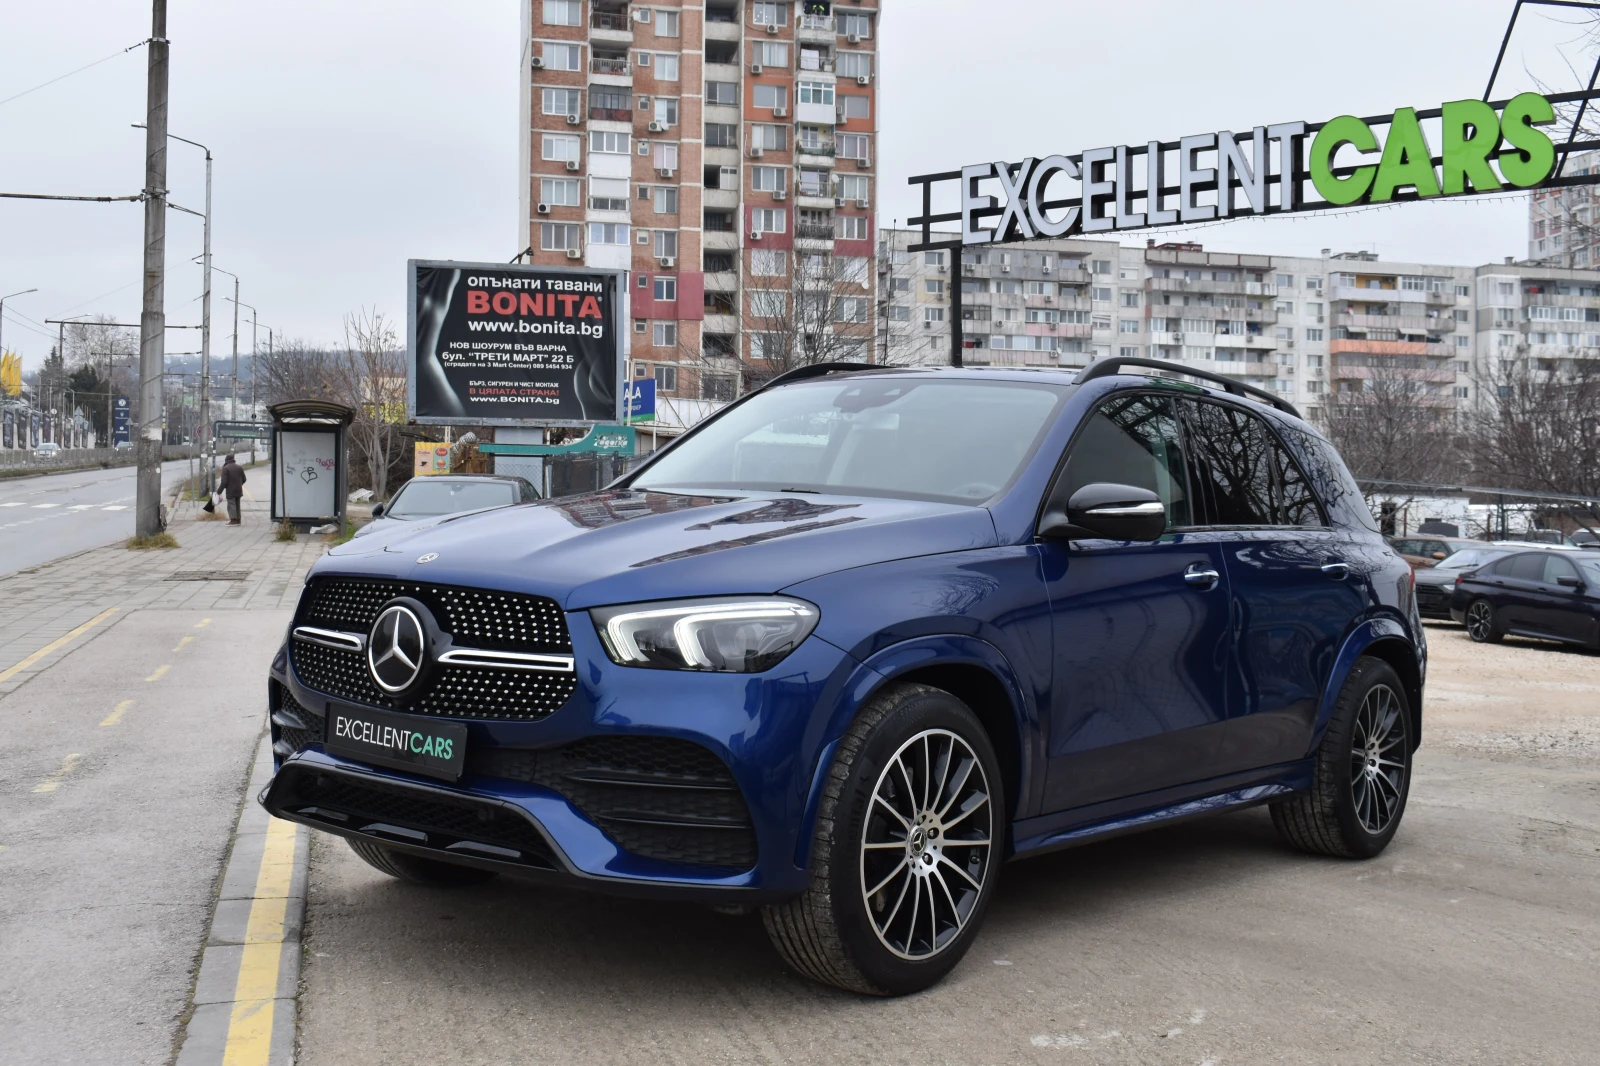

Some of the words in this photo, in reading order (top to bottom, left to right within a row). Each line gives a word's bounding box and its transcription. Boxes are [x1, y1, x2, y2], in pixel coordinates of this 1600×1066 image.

[961, 92, 1556, 245] EXCELLENTCARS
[467, 276, 541, 289] опънати
[546, 279, 603, 292] тавани
[467, 290, 603, 319] BONITA
[468, 320, 603, 338] www.bonita.bg
[472, 342, 512, 350] ШОУРУМ
[514, 343, 535, 351] ВЪВ
[536, 344, 567, 352] ВАРНА
[442, 352, 466, 361] бул.
[551, 355, 564, 363] 22
[566, 355, 574, 363] Б
[469, 387, 476, 395] В
[479, 388, 517, 396] ЦЯЛАТА
[519, 388, 560, 396] СТРАНА!
[470, 396, 560, 405] www.BONITA.bg
[336, 716, 453, 760] EXCELLENTCARS
